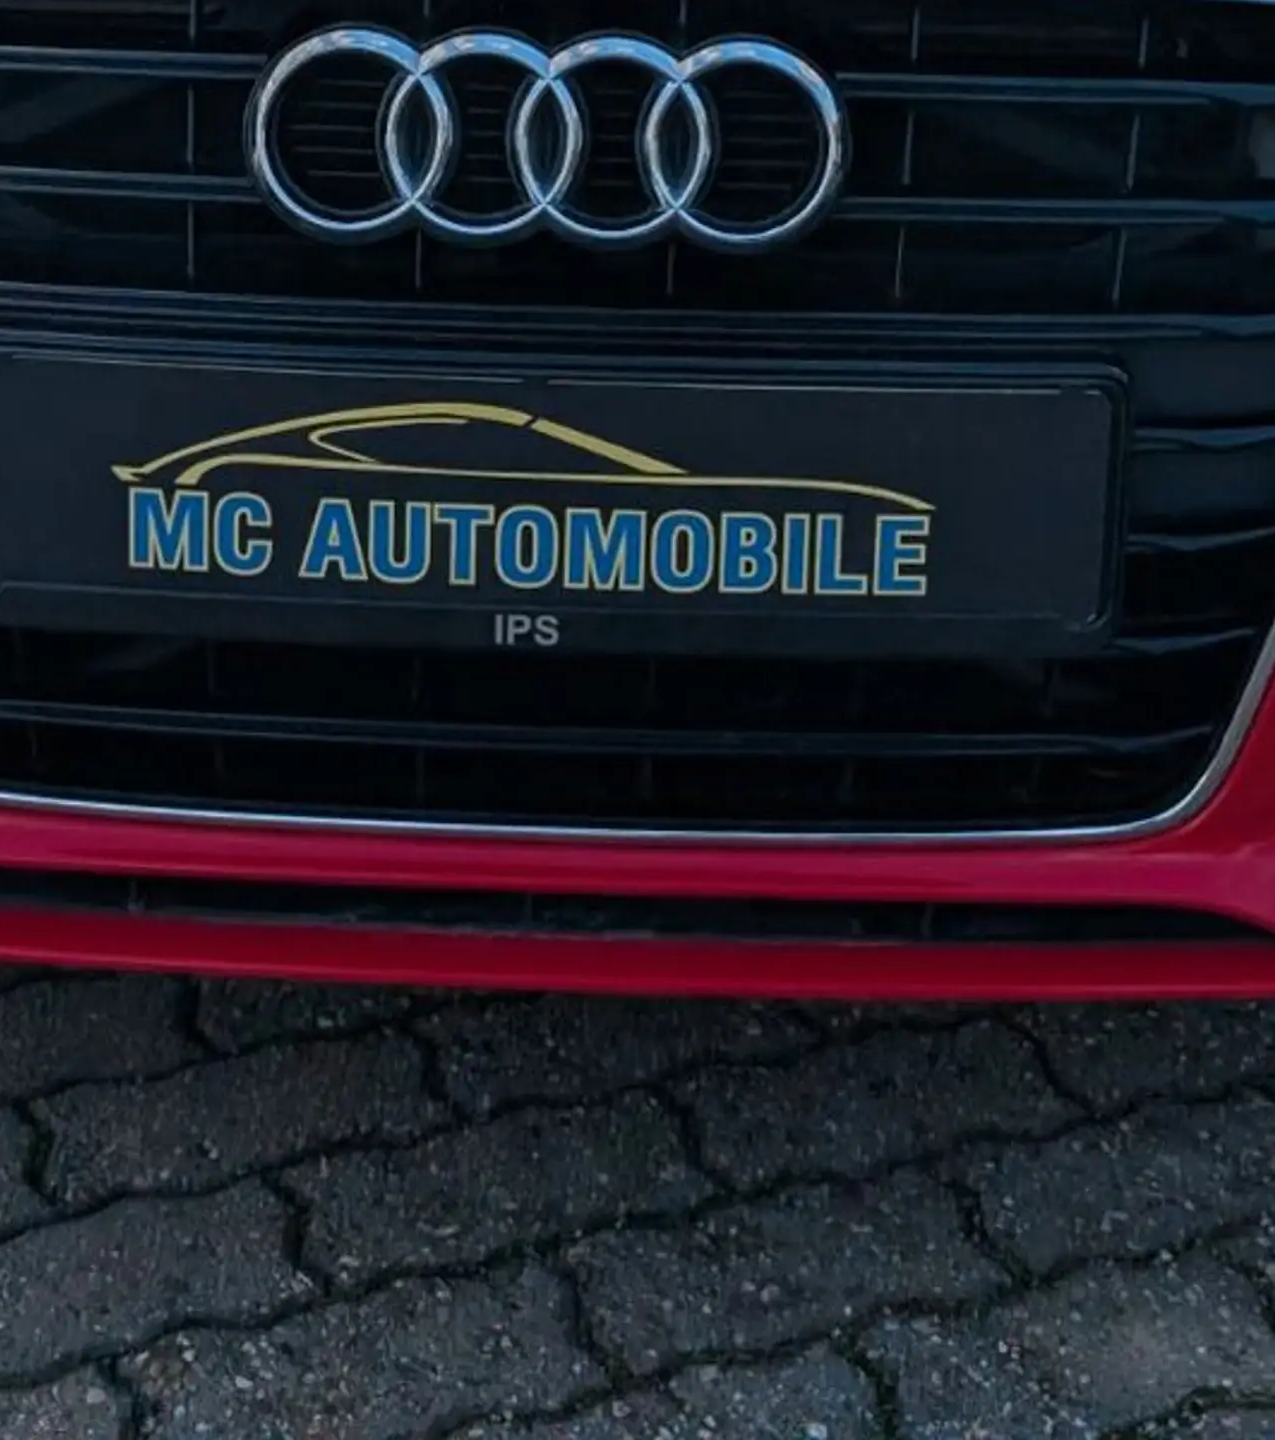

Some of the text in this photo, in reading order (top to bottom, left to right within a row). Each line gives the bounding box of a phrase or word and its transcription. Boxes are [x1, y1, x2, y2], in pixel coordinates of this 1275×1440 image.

[128, 486, 931, 596] MC AUTOMOBILE
[493, 613, 561, 646] IPS
